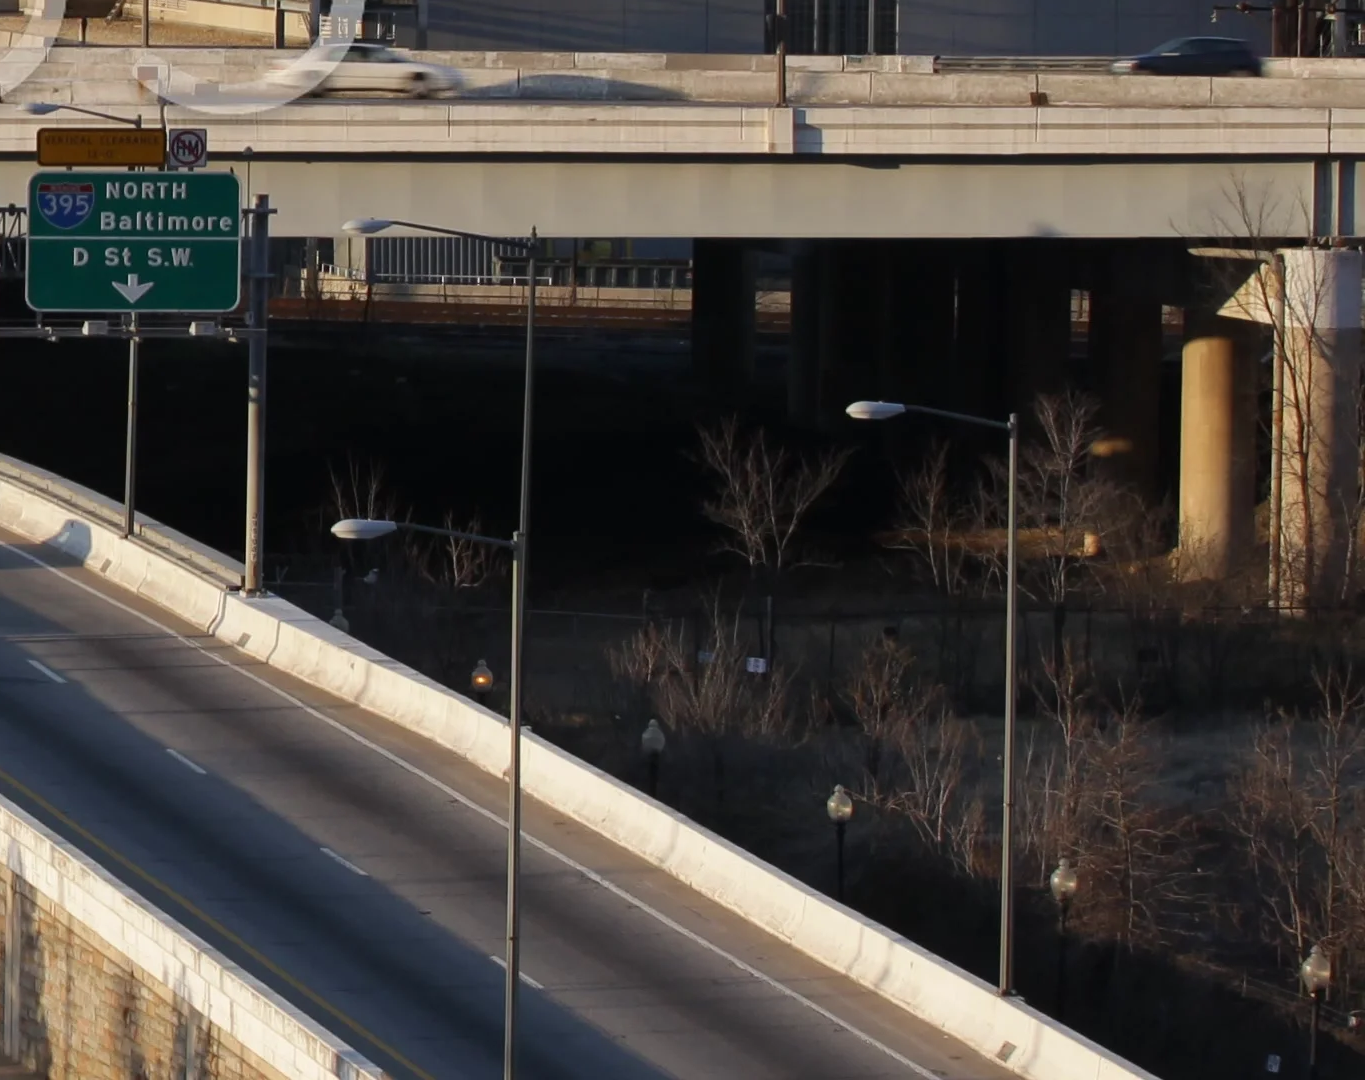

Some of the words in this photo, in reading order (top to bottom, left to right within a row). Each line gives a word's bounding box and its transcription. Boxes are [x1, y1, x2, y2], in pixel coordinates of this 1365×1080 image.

[44, 135, 92, 145] VERTICAL
[105, 182, 187, 199] NORTH
[43, 194, 90, 216] 395
[100, 211, 233, 231] Baltimore
[73, 247, 89, 266] D
[104, 247, 132, 266] St
[147, 247, 194, 266] S.W.
